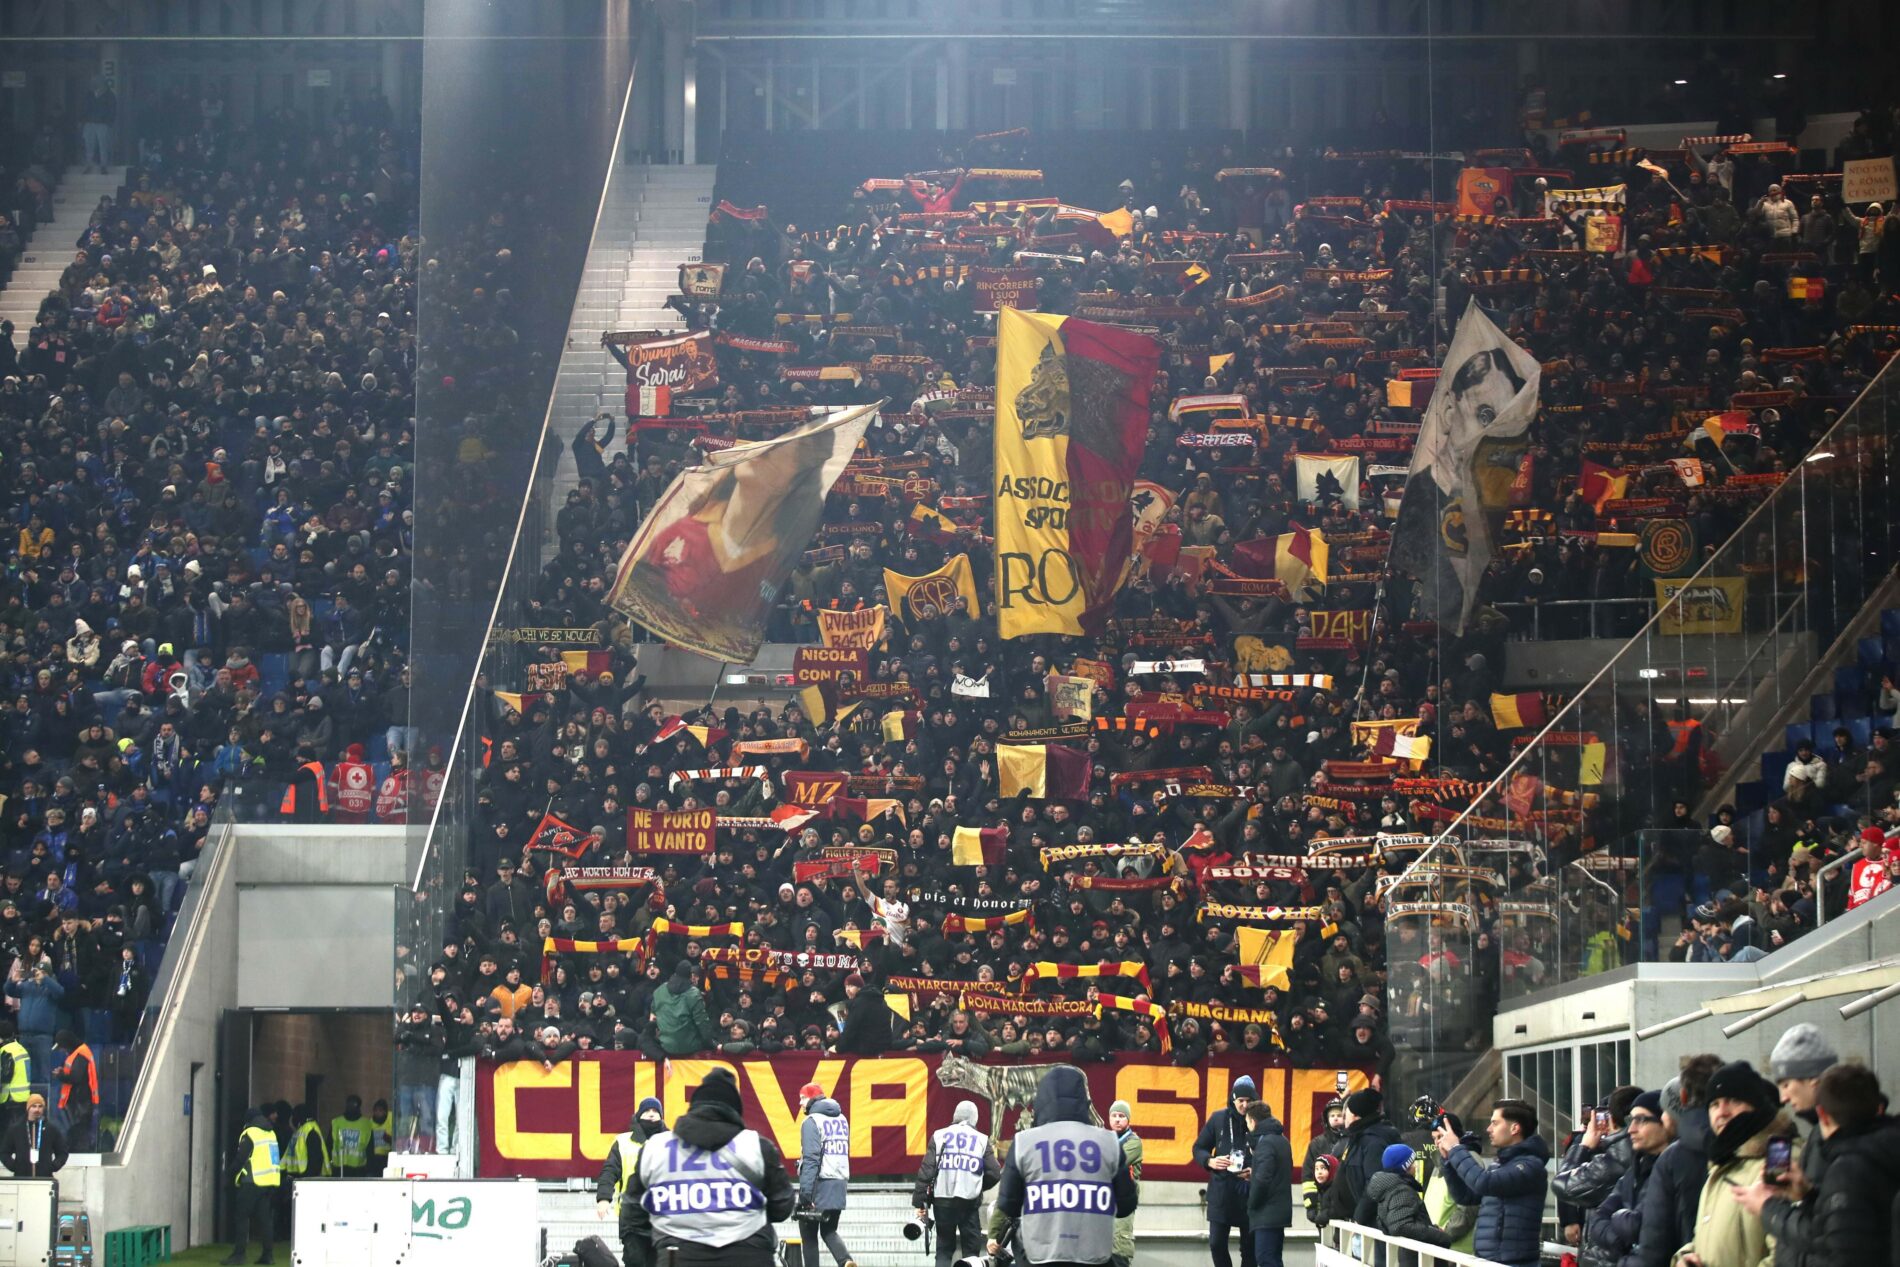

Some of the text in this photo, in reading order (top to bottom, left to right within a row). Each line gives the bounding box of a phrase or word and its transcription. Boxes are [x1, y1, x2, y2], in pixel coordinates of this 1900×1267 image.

[1859, 177, 1889, 185] ROMA
[976, 280, 1034, 291] RINCORRERE
[996, 290, 1019, 299] SUOI
[733, 337, 785, 349] MAGICA ROMA
[628, 342, 687, 367] Ovunque
[636, 361, 688, 386] Sarai
[787, 369, 820, 377] OVUNQUE
[699, 436, 735, 448] OVUNQUE
[1340, 440, 1395, 448] FORZA ROMA
[1240, 582, 1271, 592] ROMA
[521, 629, 536, 640] CHI
[539, 630, 550, 640] VE
[551, 630, 562, 641] SE
[831, 630, 876, 650] BASTA
[802, 649, 859, 662] NICOLA
[798, 669, 831, 681] CON
[1193, 684, 1295, 703] PIGNETO
[793, 781, 842, 806] MZ
[1304, 795, 1339, 810] ROMA
[634, 811, 712, 829] NE PORTO
[538, 826, 563, 838] CAPUT
[638, 831, 707, 850] IL VANTO
[1328, 837, 1364, 846] FOLLOW
[1391, 837, 1424, 845] FOLLOW
[825, 848, 851, 859] FIGLIE
[1255, 855, 1367, 868] AZIO MERDA
[632, 867, 642, 877] CI
[1210, 867, 1294, 878] BOYS
[924, 891, 947, 903] vis
[953, 896, 967, 906] et
[814, 954, 860, 969] ROMA
[889, 978, 1007, 995] OMA MARCIA ANCORA
[968, 994, 1093, 1013] ROMA MARCIA ANCORA
[1186, 1001, 1273, 1024] MAGLIANA
[942, 1131, 978, 1152] 261
[1034, 1139, 1102, 1174] 169
[650, 1182, 753, 1211] PHOTO
[1026, 1182, 1112, 1212] PHOTO
